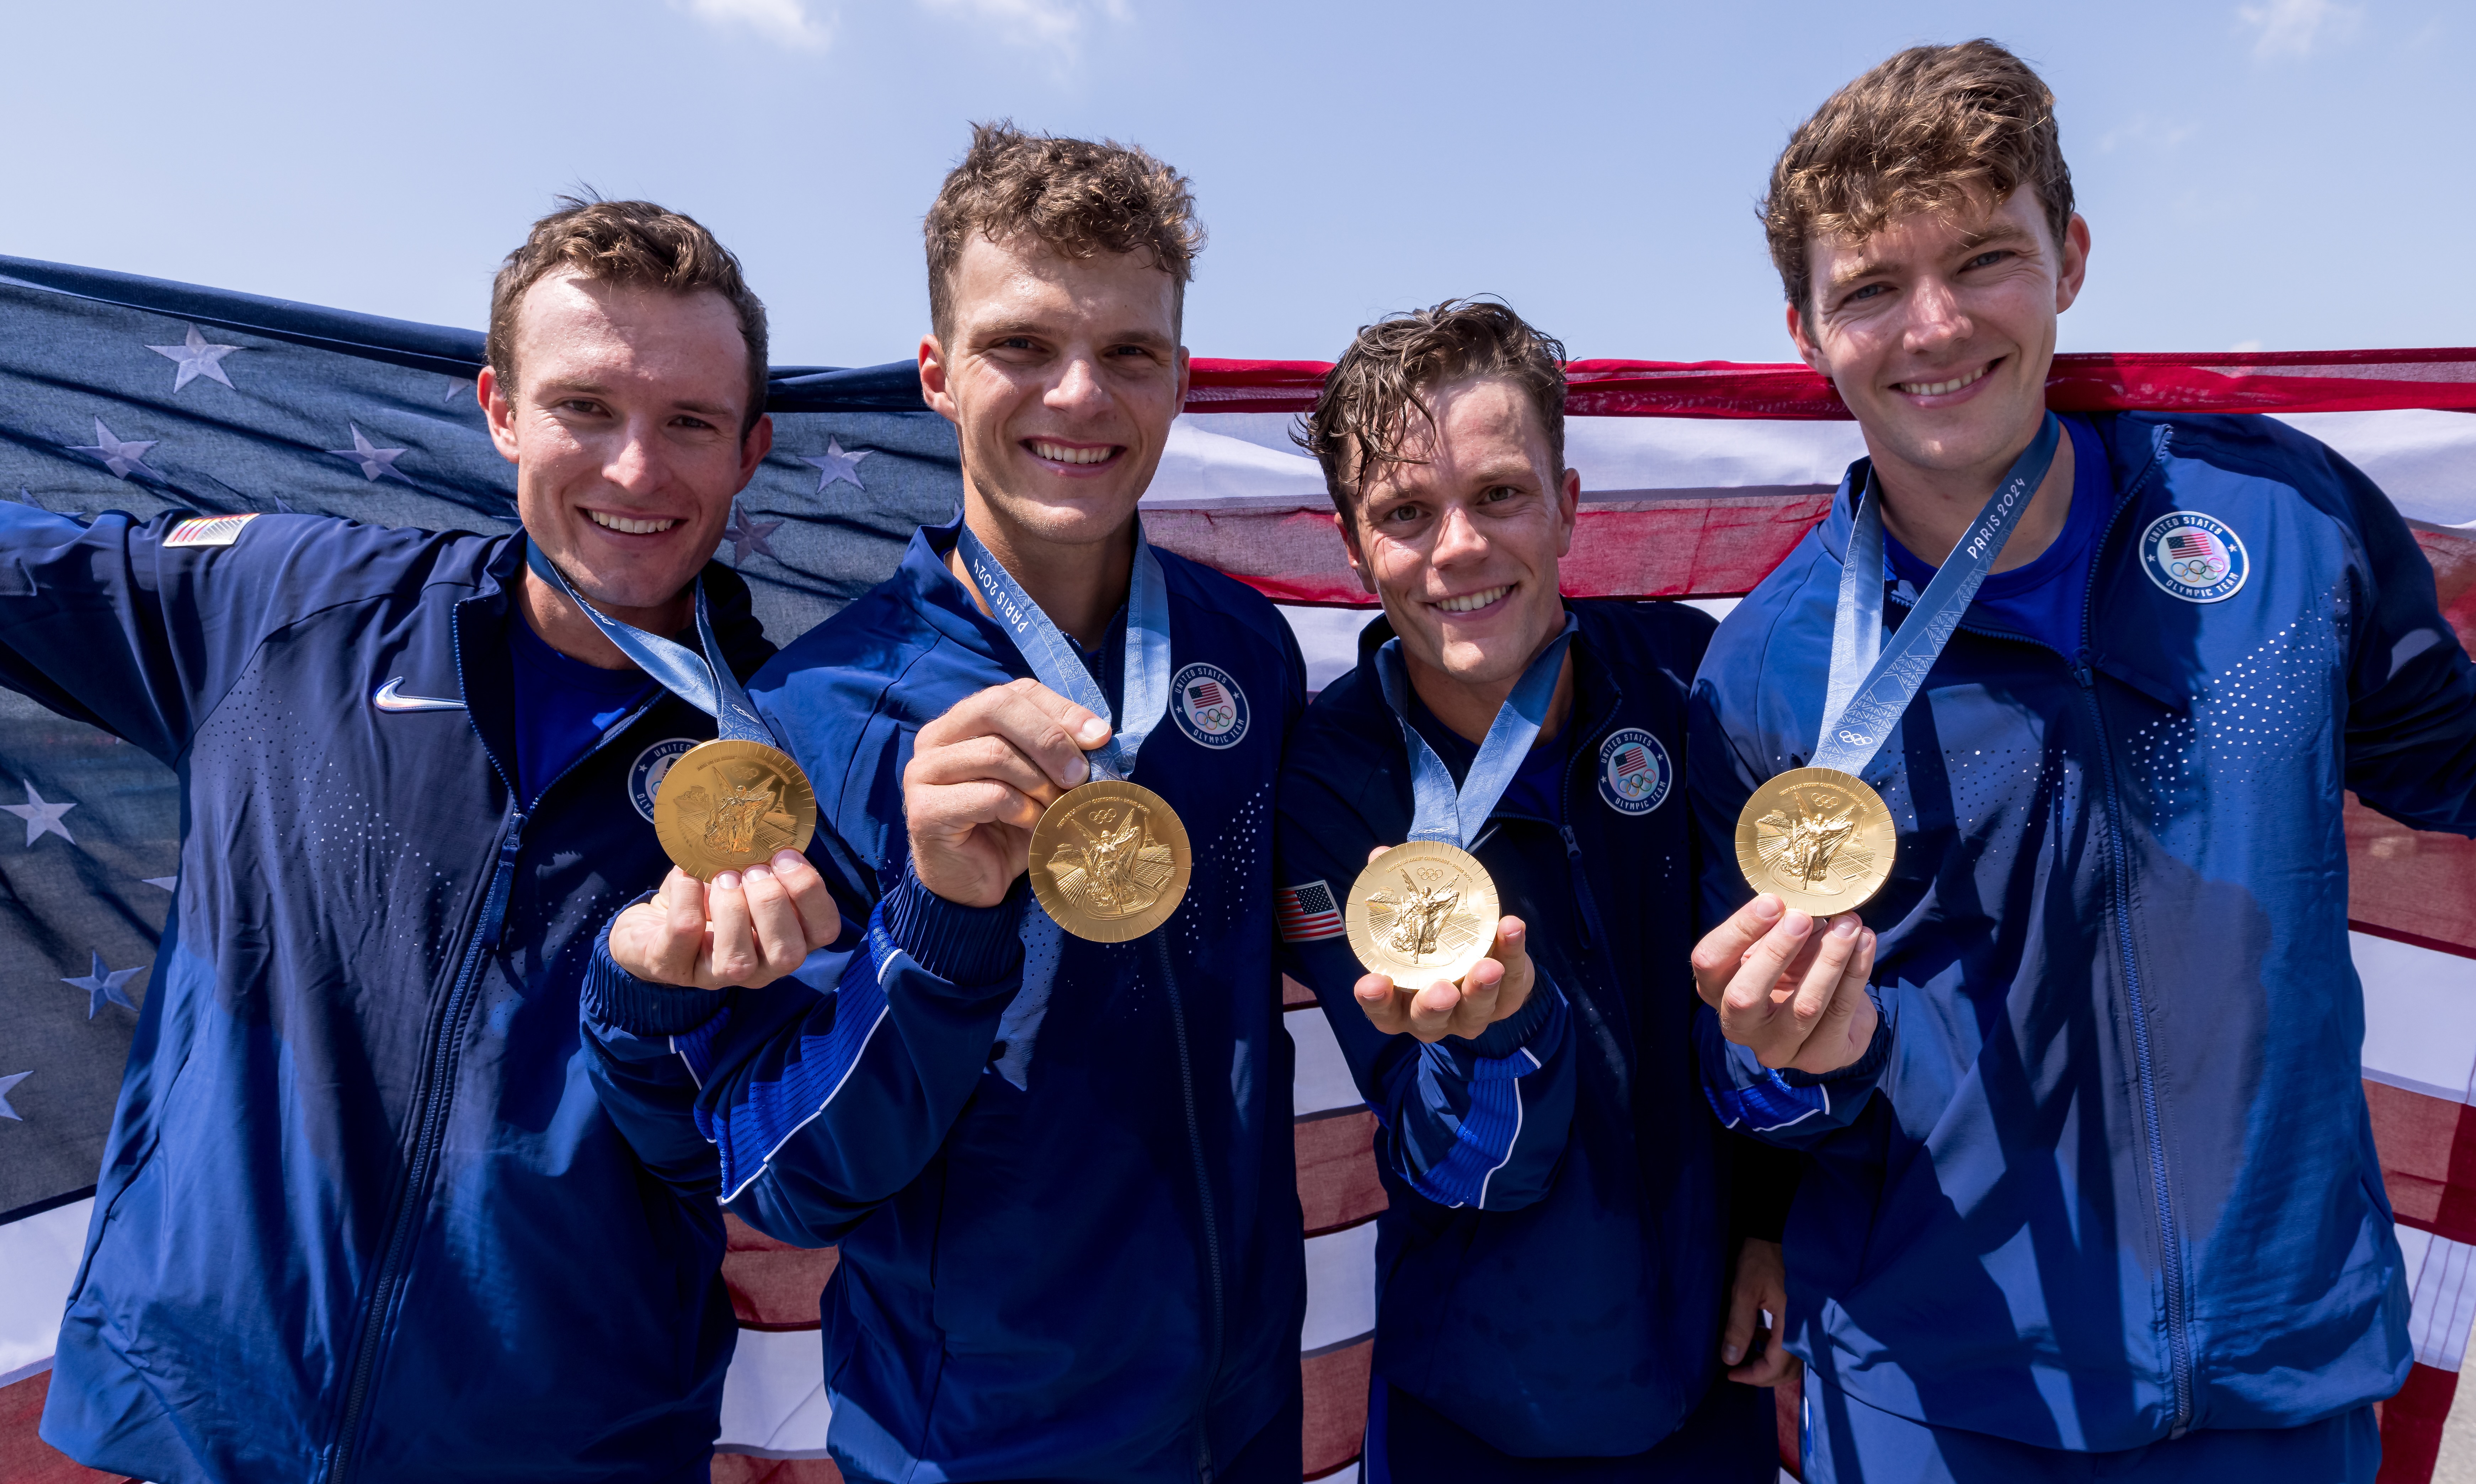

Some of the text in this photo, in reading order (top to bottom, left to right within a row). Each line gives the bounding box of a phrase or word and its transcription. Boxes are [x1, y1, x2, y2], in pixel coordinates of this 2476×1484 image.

[1997, 478, 2025, 517] 2024
[2149, 516, 2223, 542] UNITED STATES
[974, 558, 999, 596] 2024
[2166, 572, 2239, 597] OLYMPIC TEAM
[1175, 668, 1227, 693] UNITED STATES
[1193, 718, 1244, 744] OLYMPIC TEAM
[653, 744, 691, 757] UNITED
[1601, 733, 1652, 764] UNITED STATES
[637, 793, 654, 815] OLYM
[1615, 781, 1666, 810] OLYMPIC TEAM
[1386, 864, 1397, 873] JEUX
[1424, 856, 1449, 865] OLYMPIADE
